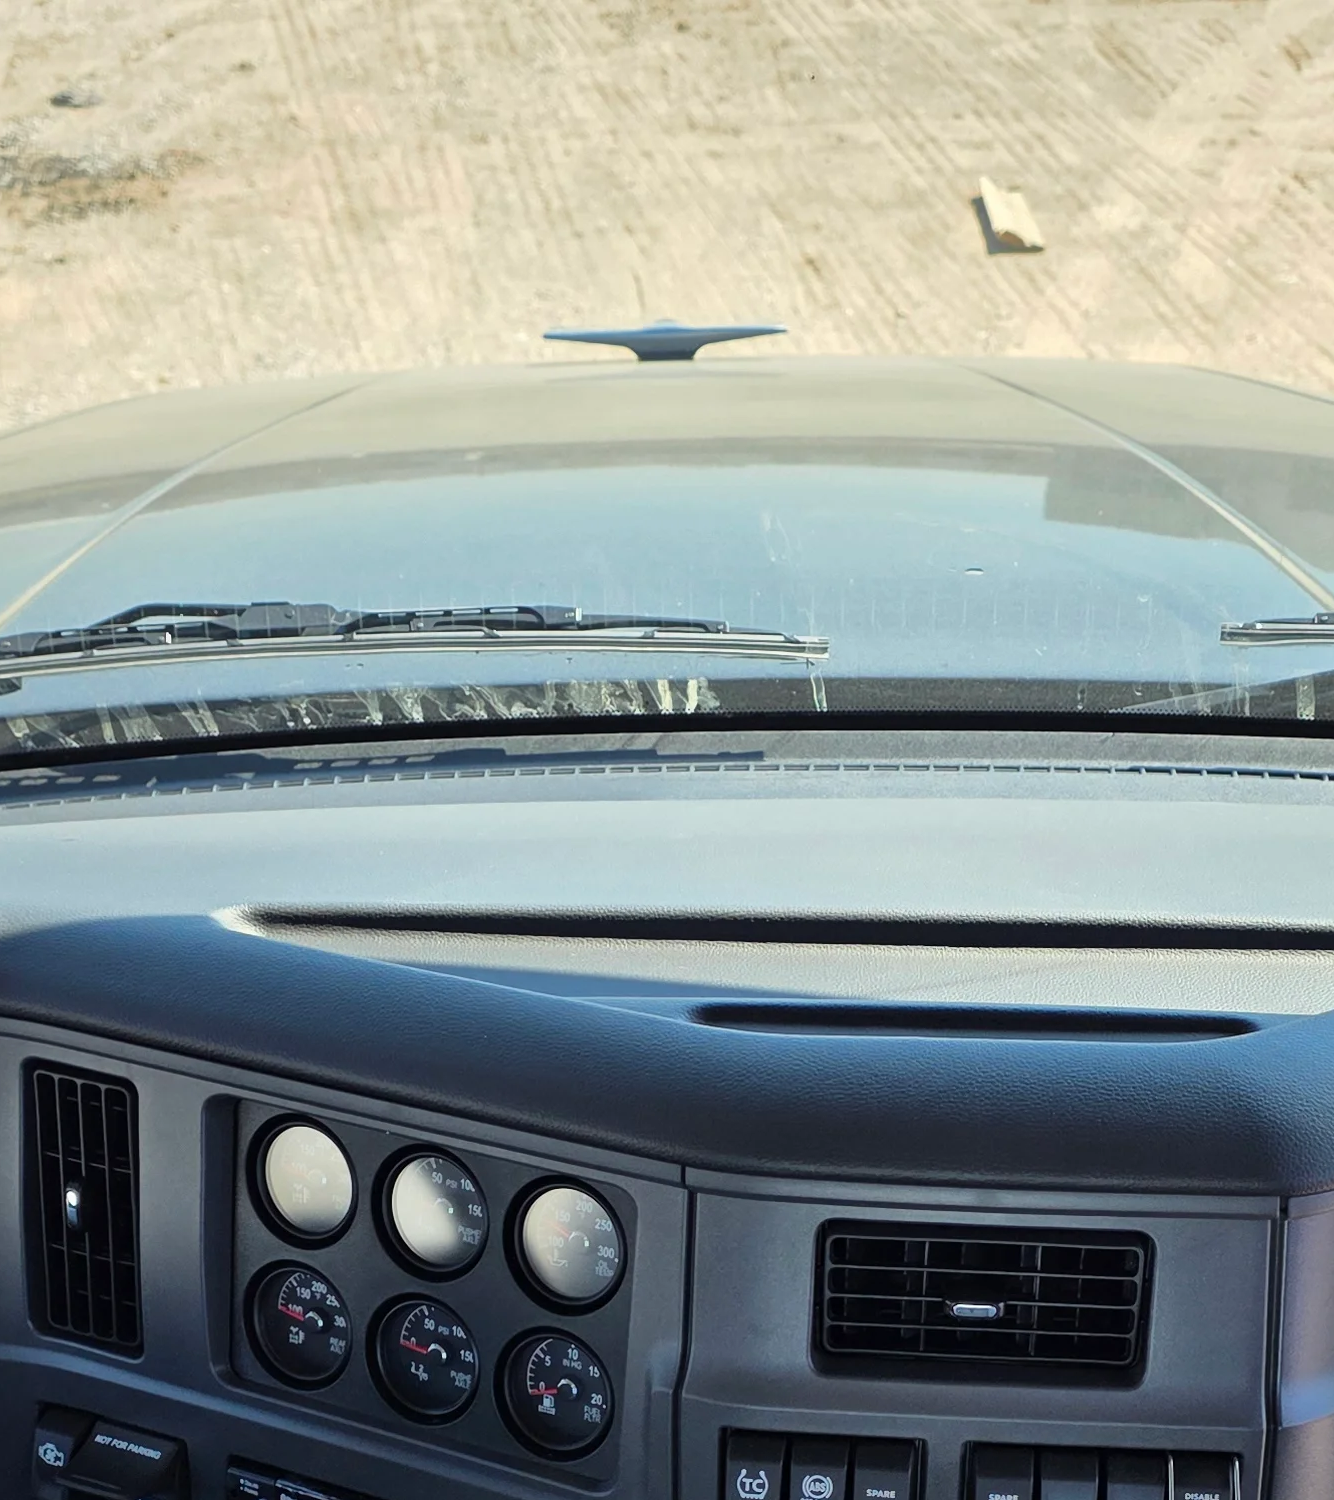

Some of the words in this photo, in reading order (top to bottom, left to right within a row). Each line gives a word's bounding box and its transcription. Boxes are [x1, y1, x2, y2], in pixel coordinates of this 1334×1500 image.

[431, 1171, 444, 1184] 50
[446, 1179, 458, 1189] PSI
[576, 1200, 593, 1213] 200
[594, 1218, 613, 1232] 250
[597, 1244, 615, 1259] 300
[295, 1286, 311, 1300] 150
[311, 1280, 327, 1294] 200
[423, 1318, 435, 1331] 50
[437, 1325, 450, 1336] PSI
[567, 1348, 579, 1360] 10
[544, 1355, 551, 1367] 5
[588, 1365, 600, 1378] 15
[539, 1381, 546, 1391] 0
[590, 1393, 603, 1406] 20
[95, 1434, 113, 1447] NOT
[113, 1438, 128, 1451] FOR
[127, 1443, 162, 1460] PARKING
[742, 1477, 764, 1493] TC
[809, 1481, 827, 1493] ABS
[866, 1488, 896, 1499] SPARE
